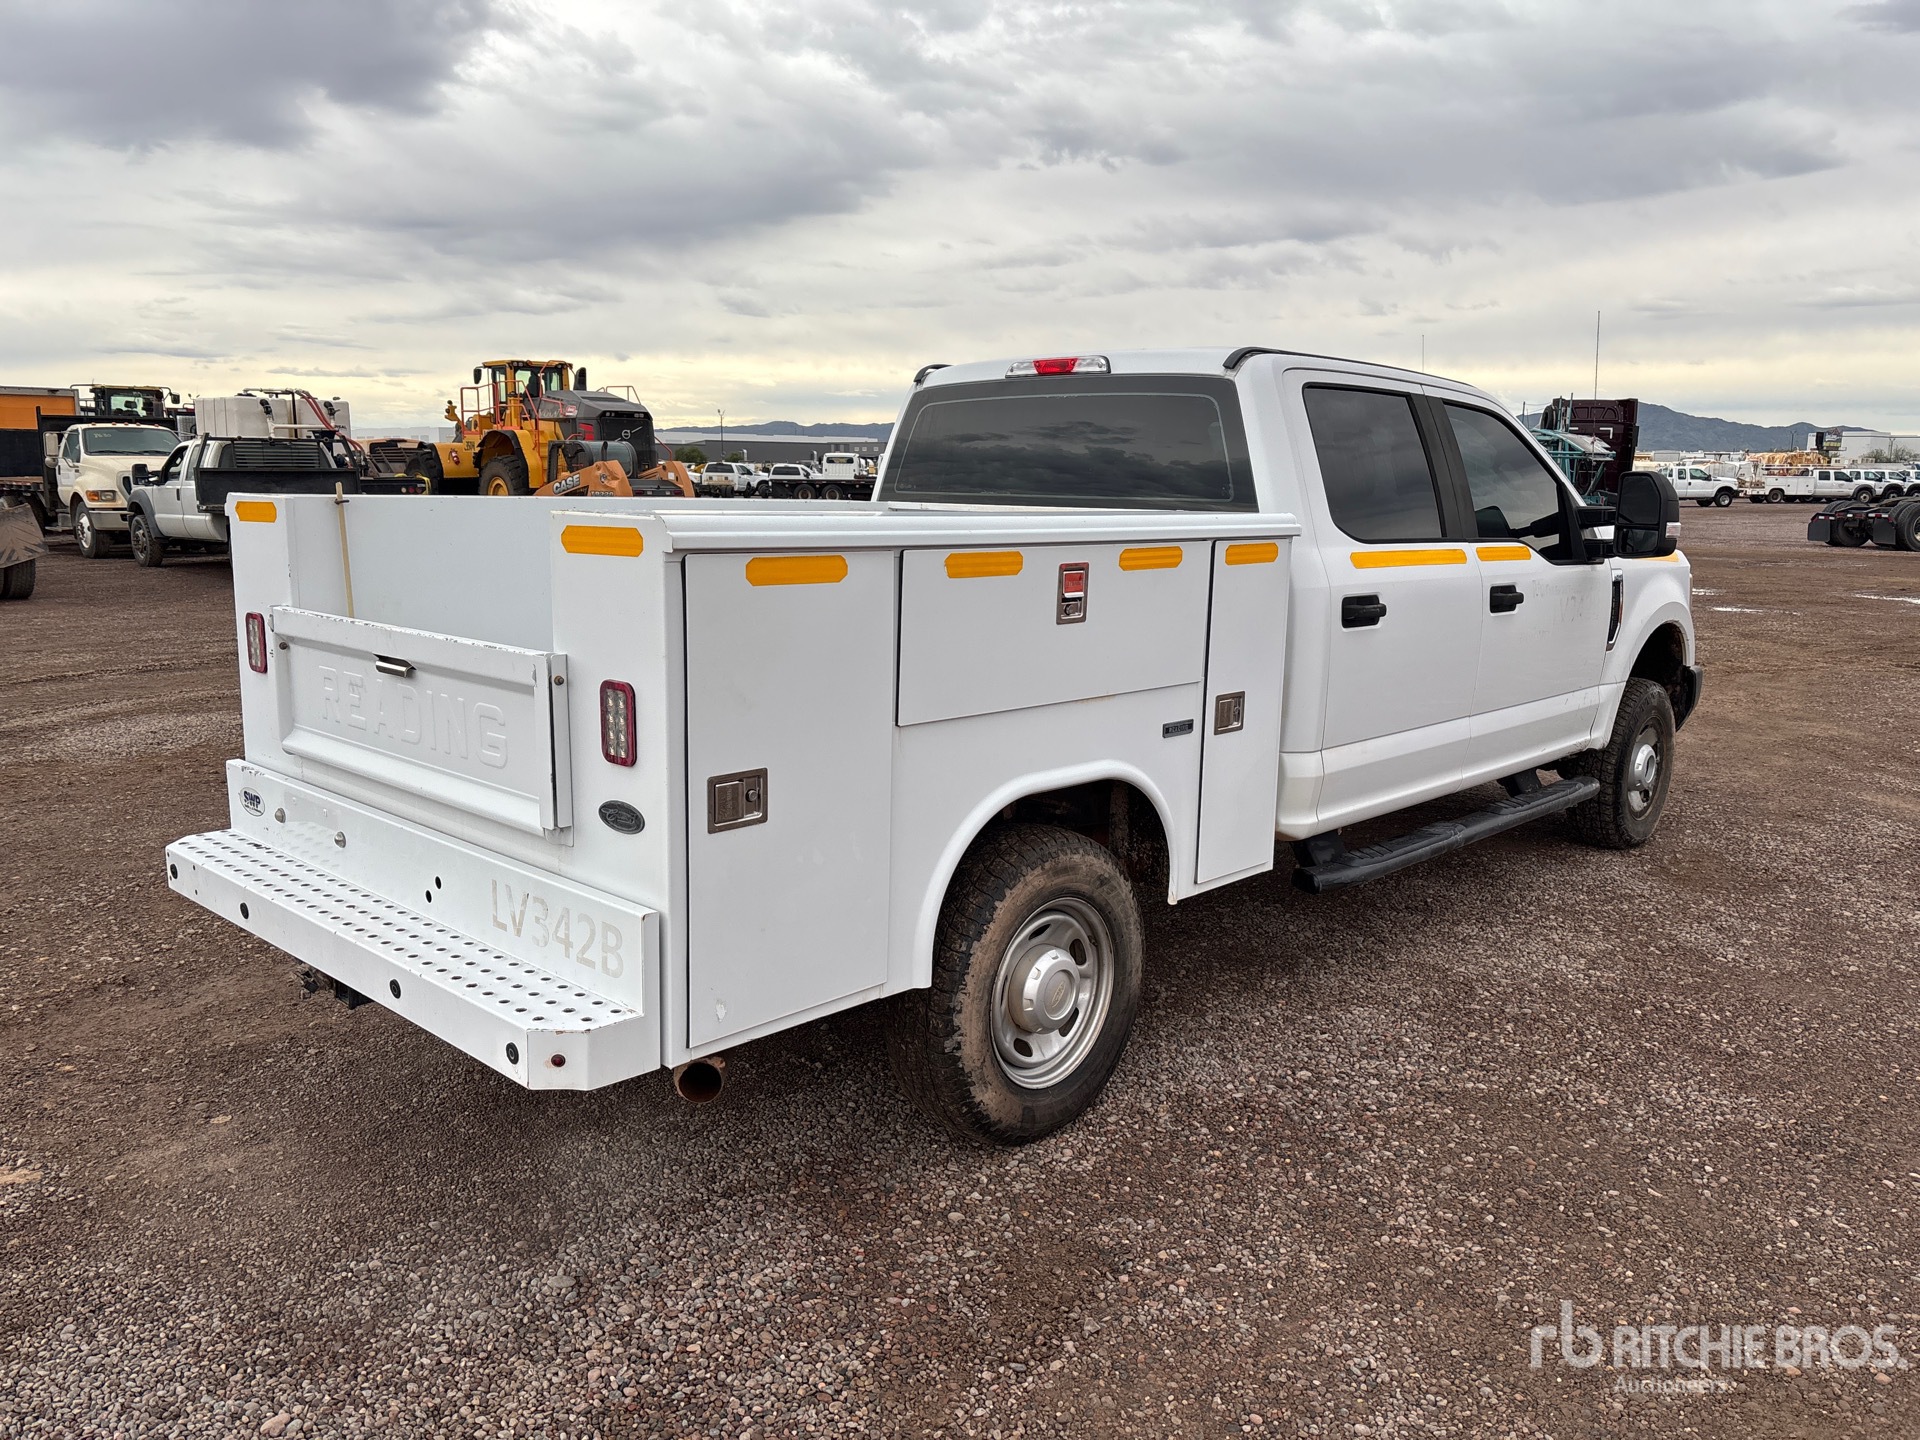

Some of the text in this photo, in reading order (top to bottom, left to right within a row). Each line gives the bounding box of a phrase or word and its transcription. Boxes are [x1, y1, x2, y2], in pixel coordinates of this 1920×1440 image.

[553, 474, 580, 494] CASE
[318, 665, 508, 769] READING
[491, 879, 624, 978] LV342B
